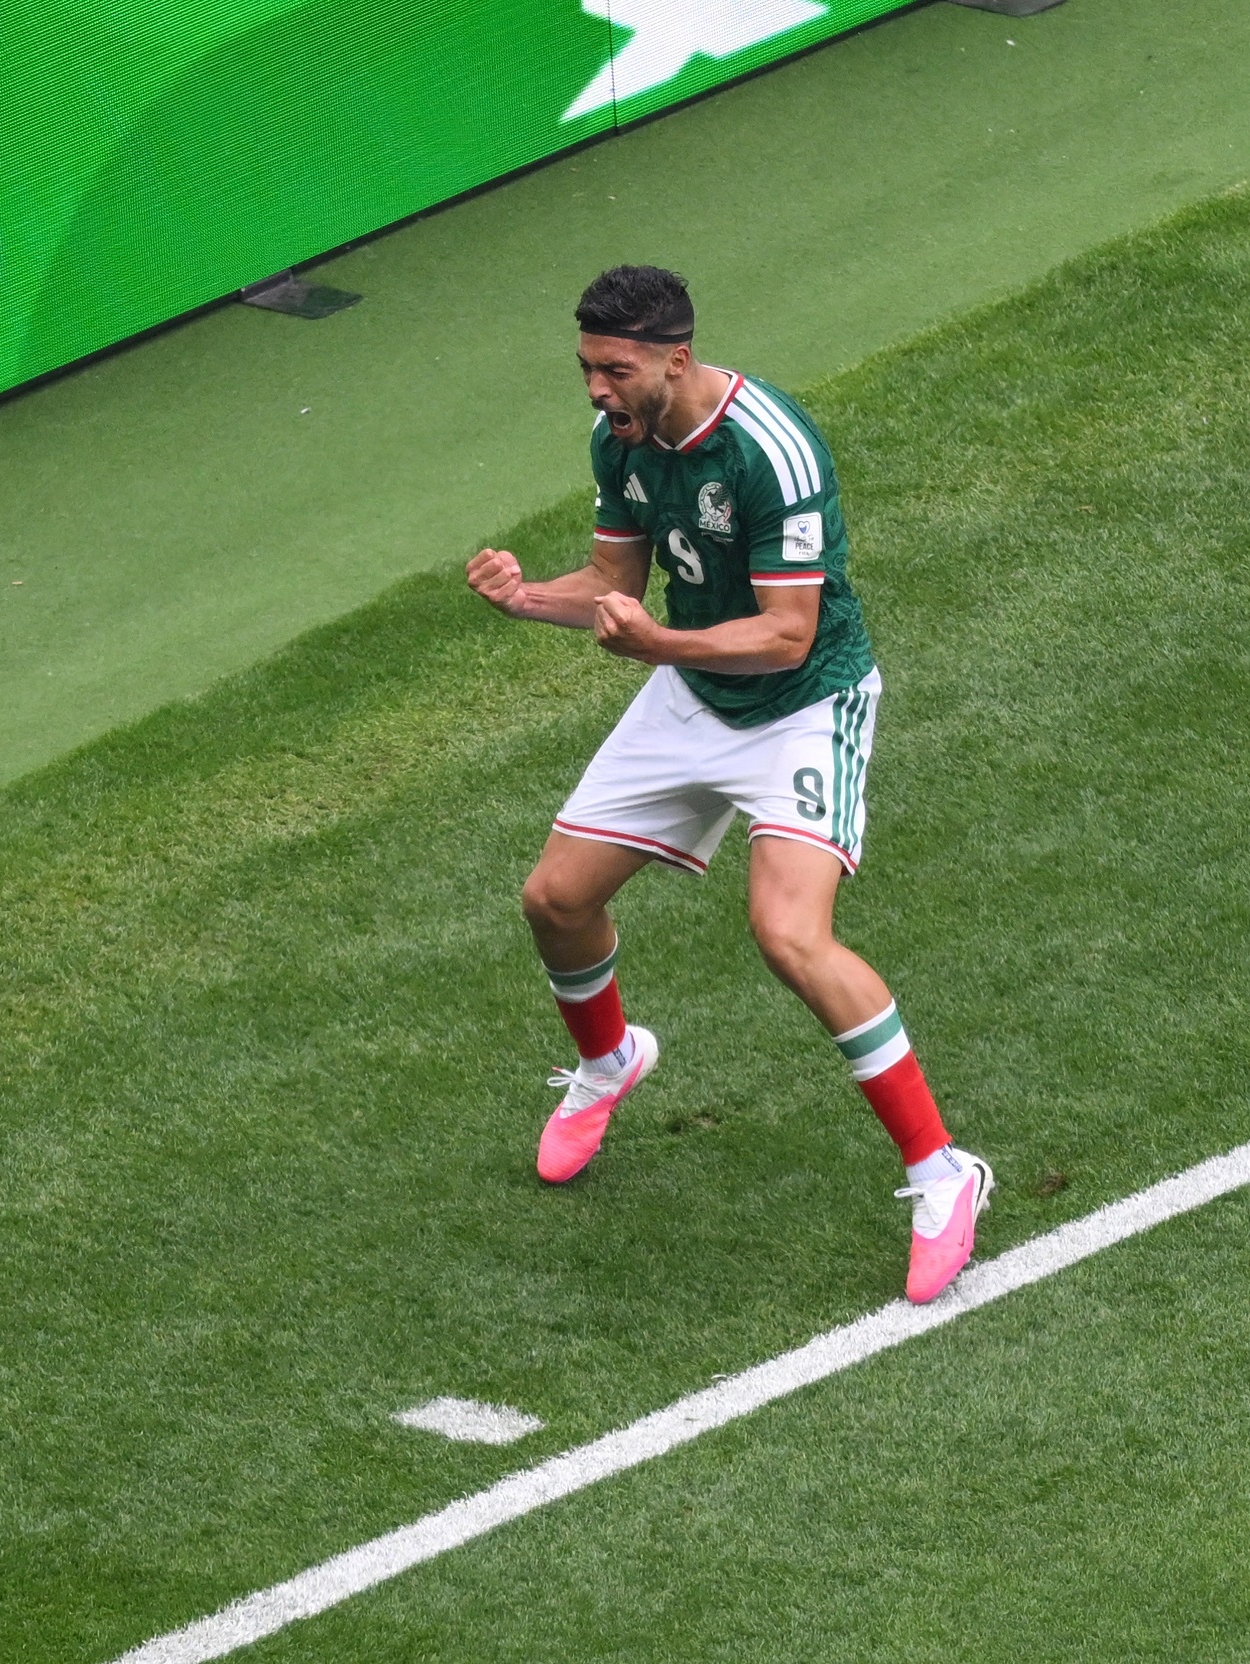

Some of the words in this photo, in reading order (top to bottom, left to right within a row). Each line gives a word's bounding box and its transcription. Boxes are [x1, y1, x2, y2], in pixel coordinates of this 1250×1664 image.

[668, 528, 705, 585] 9
[794, 542, 814, 551] PEACE
[793, 767, 826, 821] 9
